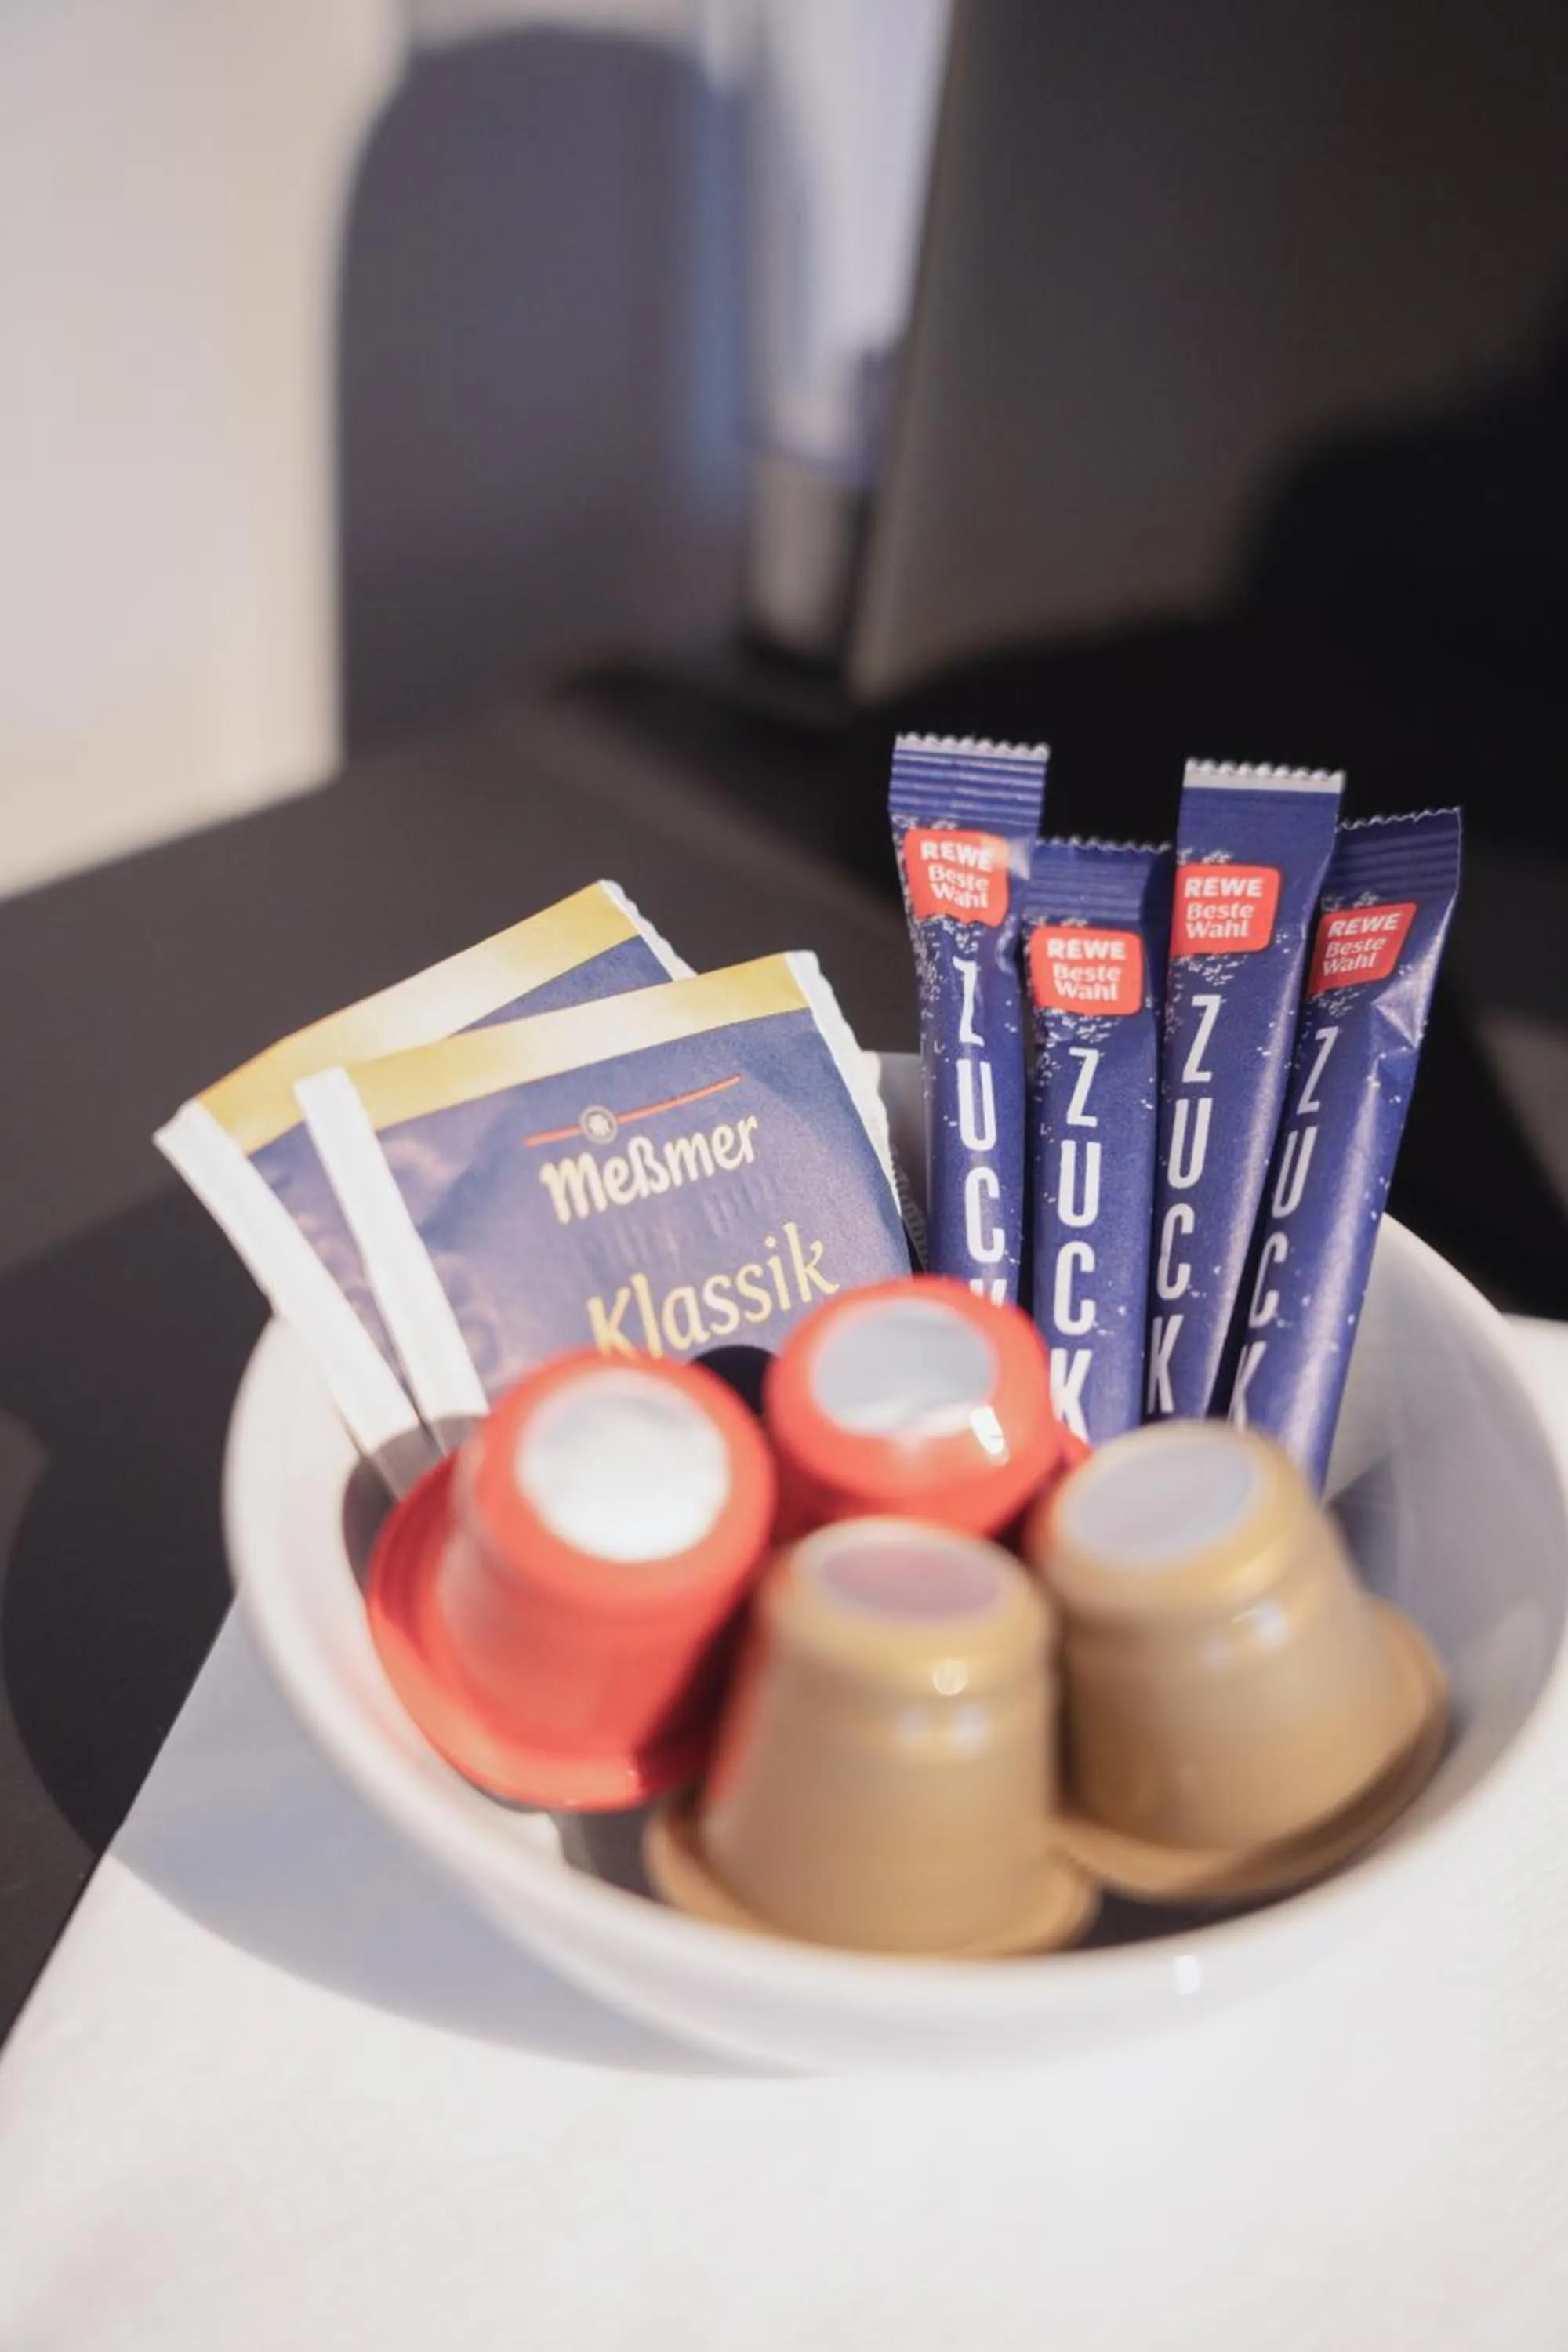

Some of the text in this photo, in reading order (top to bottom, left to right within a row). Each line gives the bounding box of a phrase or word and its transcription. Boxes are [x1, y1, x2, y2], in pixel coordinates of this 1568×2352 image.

[920, 840, 993, 873] REWE
[927, 864, 989, 892] Beste
[1183, 877, 1265, 898] REWE
[931, 883, 989, 909] Wahl
[1185, 902, 1254, 921] Beste
[1185, 919, 1250, 939] Wahl
[1327, 912, 1402, 938] REWE
[1047, 937, 1127, 960] REWE
[1325, 937, 1387, 959] Beste
[1052, 962, 1121, 982] Beste
[1322, 952, 1376, 976] Wahl
[1054, 979, 1119, 1001] Wahl
[539, 1115, 758, 1225] Meßmer
[586, 1221, 840, 1359] Klassik
